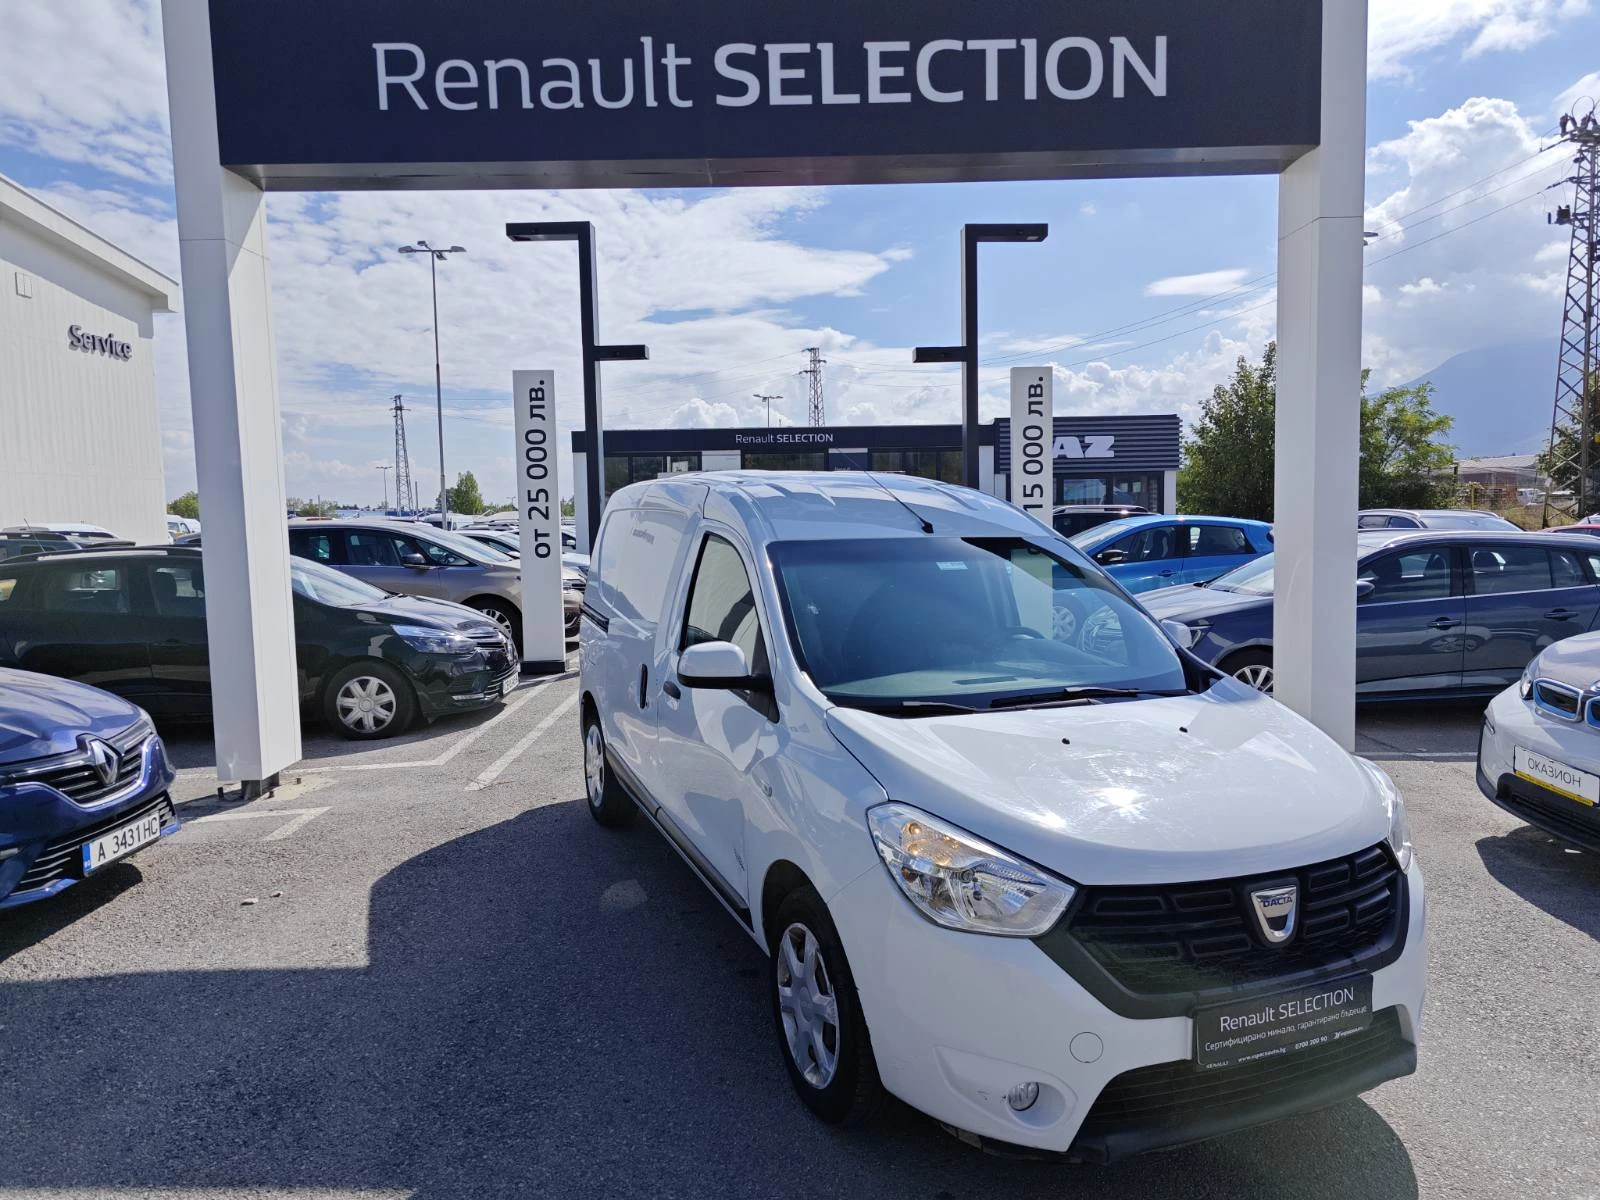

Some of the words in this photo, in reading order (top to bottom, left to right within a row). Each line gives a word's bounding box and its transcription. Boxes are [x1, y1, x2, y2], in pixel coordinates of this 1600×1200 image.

[372, 36, 694, 111] Renault
[713, 35, 1168, 107] SELECTION
[67, 324, 132, 361] Service
[525, 428, 548, 480] 000
[735, 434, 775, 444] Renault
[776, 433, 834, 443] SELECTION
[1022, 425, 1044, 475] 000
[1052, 435, 1115, 459] AZ
[528, 488, 550, 521] 25
[1023, 483, 1044, 512] 15
[534, 529, 551, 559] от
[1527, 757, 1581, 788] ОКАЗИОН
[98, 842, 106, 862] A
[1263, 896, 1293, 908] DACIA
[1220, 1006, 1275, 1033] Renault
[1278, 986, 1354, 1020] SELECTION
